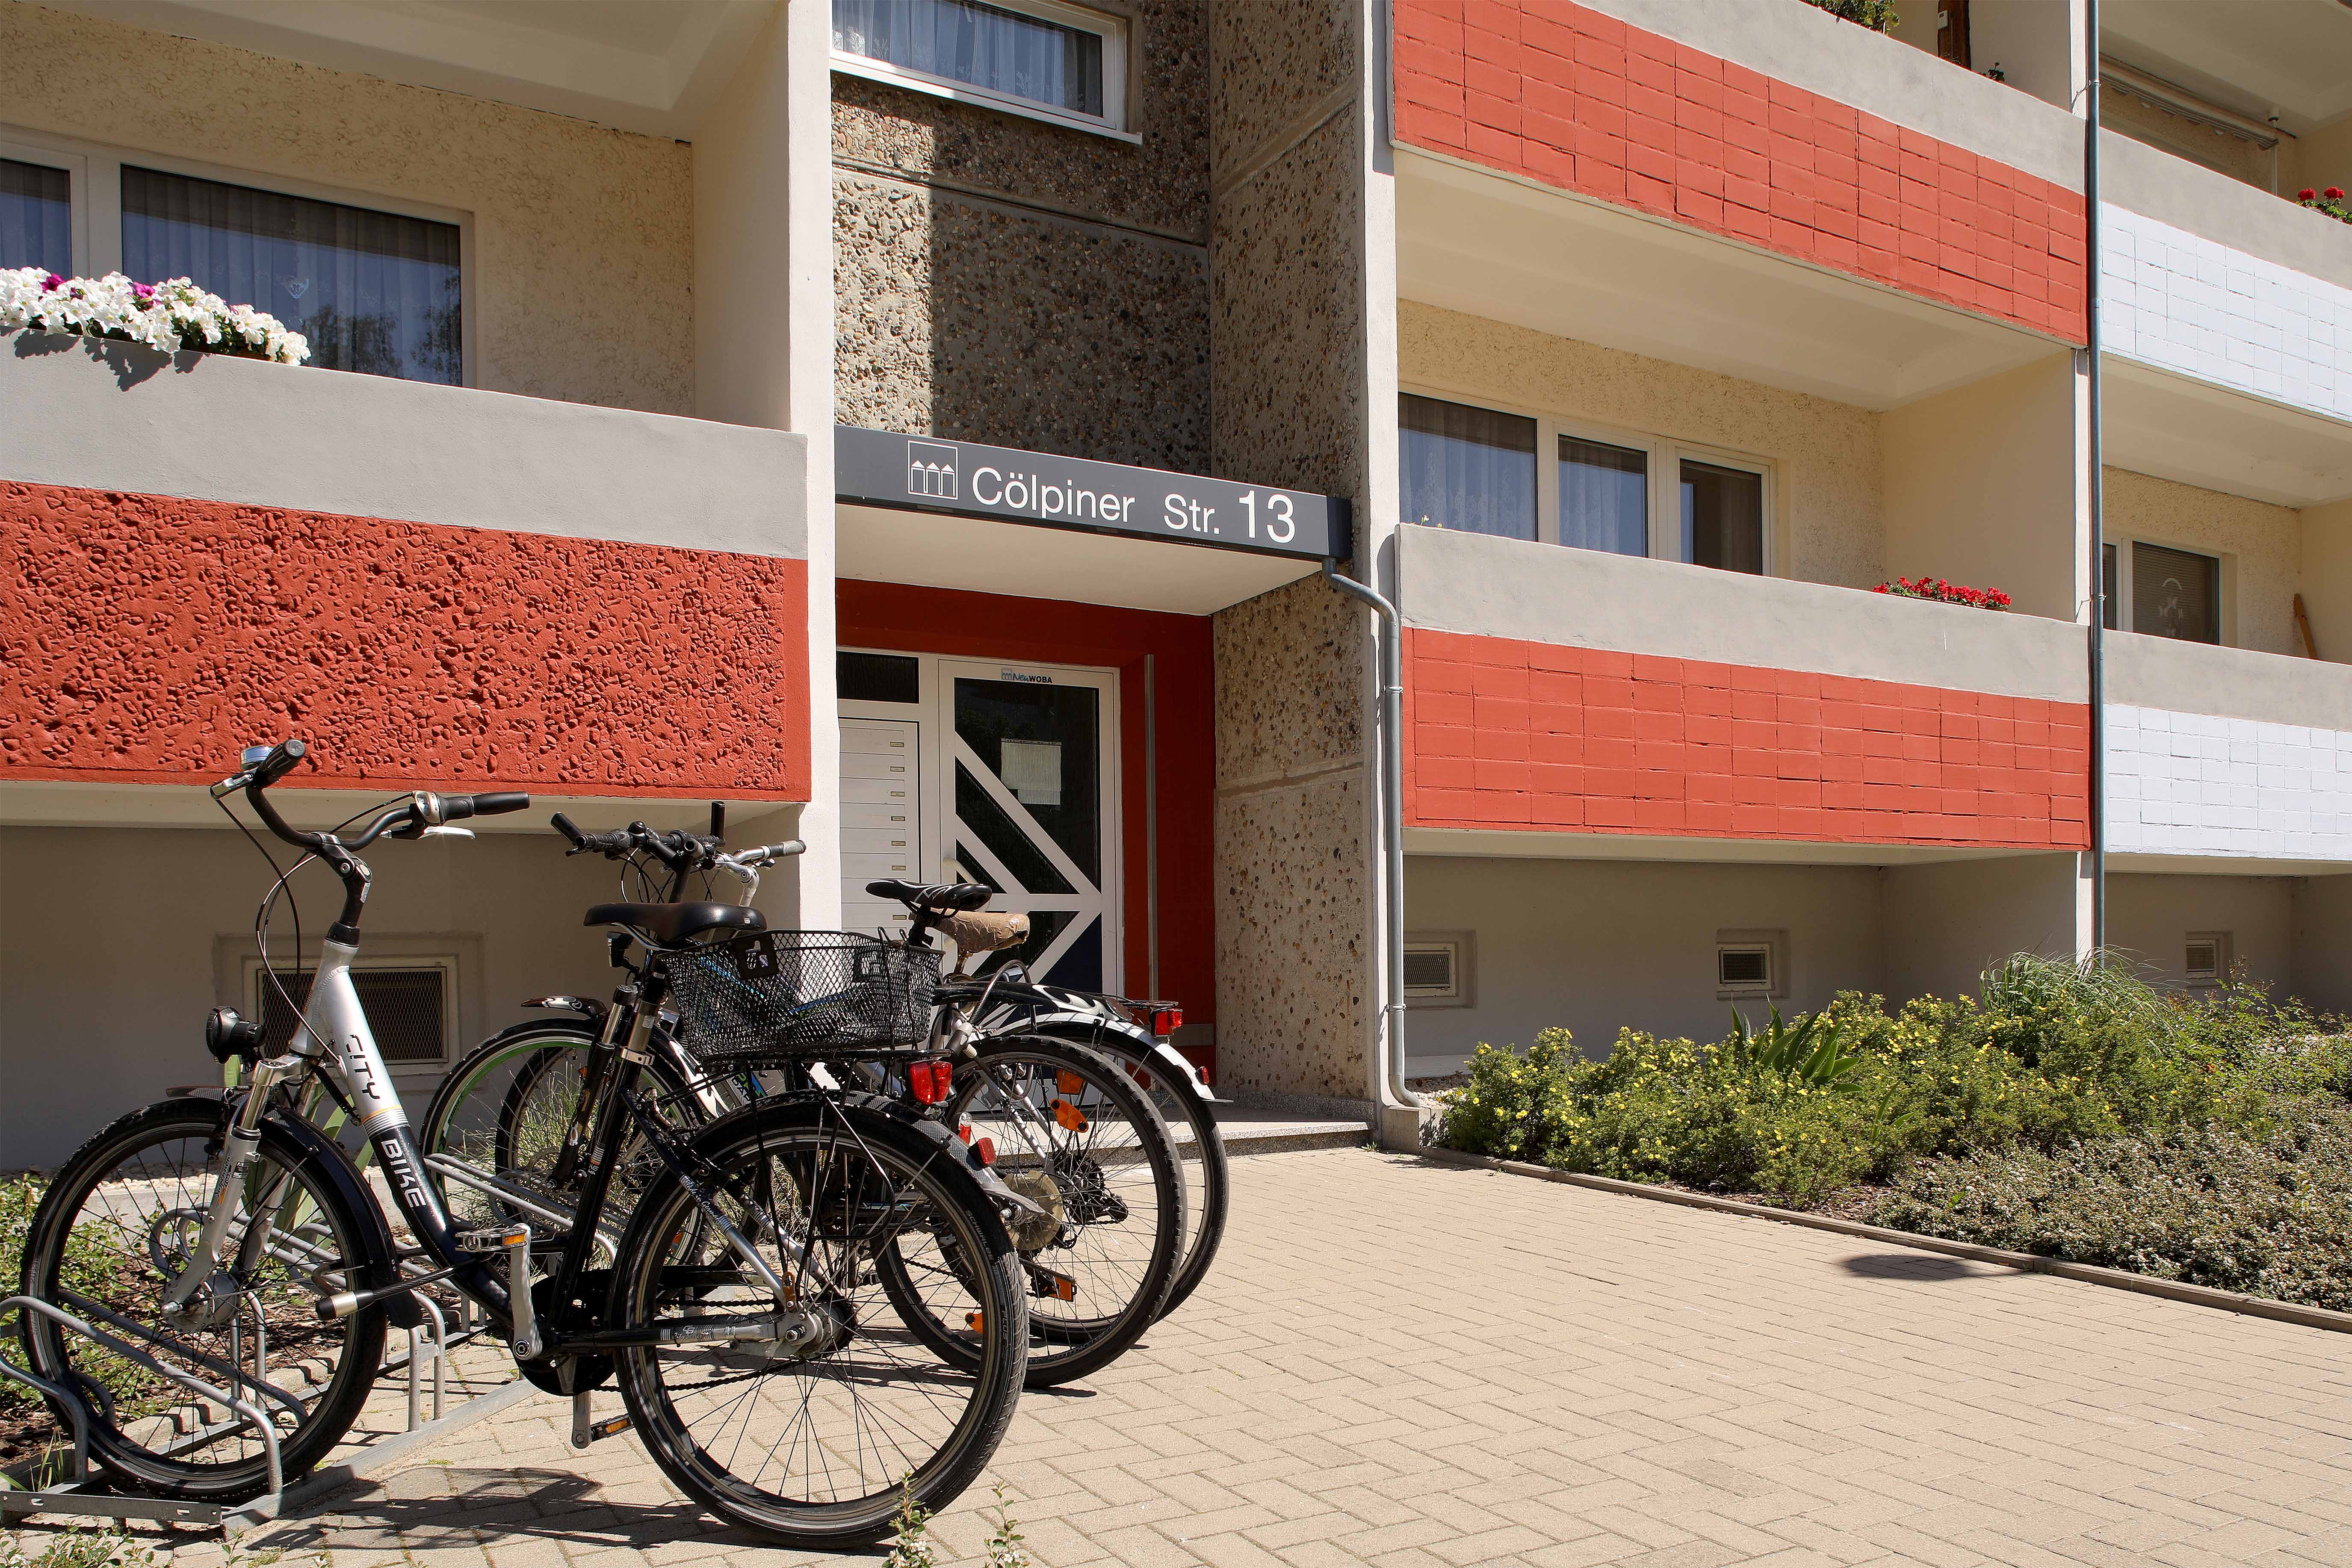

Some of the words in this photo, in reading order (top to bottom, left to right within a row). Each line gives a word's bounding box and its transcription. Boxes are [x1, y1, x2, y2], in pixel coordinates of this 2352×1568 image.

[972, 467, 1135, 522] Cölpiner
[1164, 493, 1220, 534] Str.
[1238, 490, 1296, 543] 13
[346, 1034, 381, 1099] CITY
[381, 1139, 427, 1208] BIKE
[966, 1210, 993, 1261] SCHWALBE
